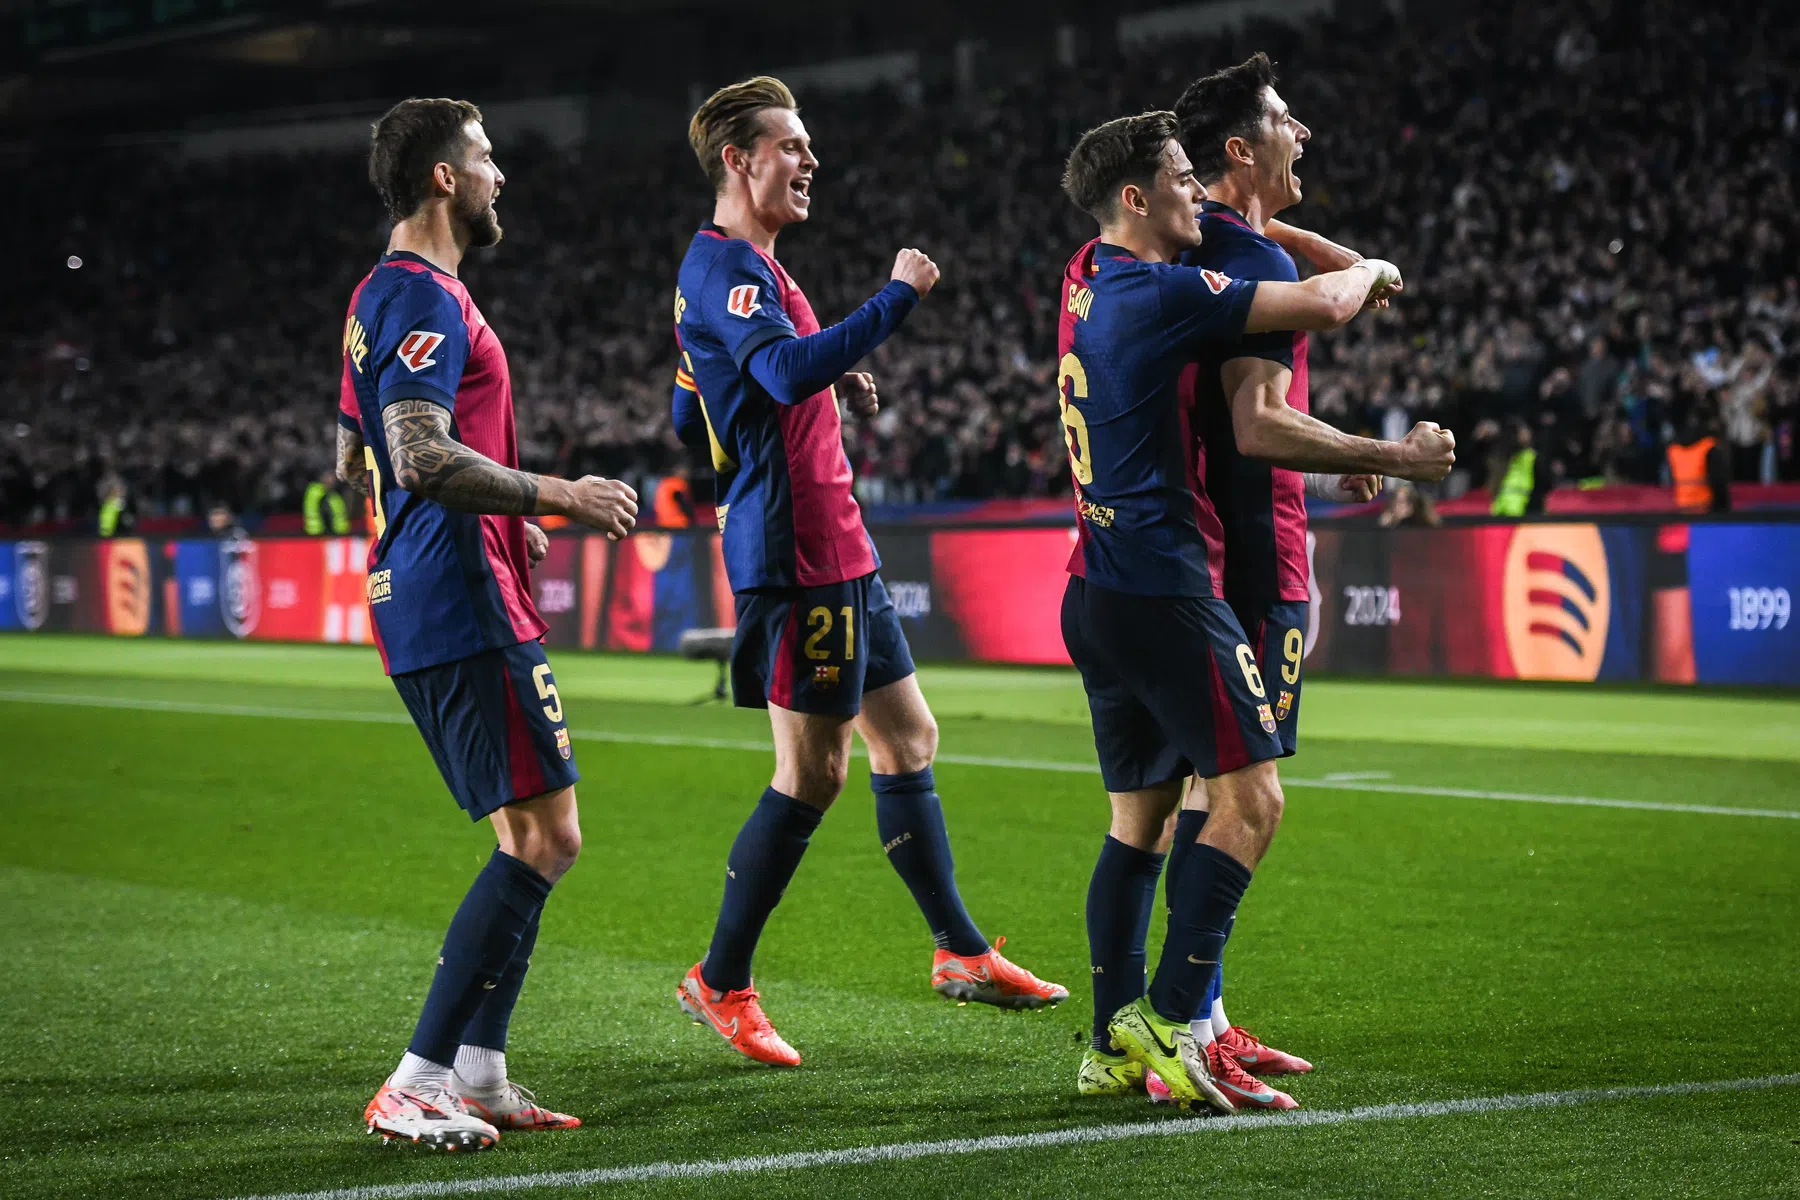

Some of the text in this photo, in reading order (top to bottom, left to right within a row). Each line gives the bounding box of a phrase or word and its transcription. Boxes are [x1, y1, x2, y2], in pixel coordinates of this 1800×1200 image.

[1067, 284, 1095, 322] GAVI
[1058, 352, 1093, 485] 6
[804, 605, 854, 660] 21
[1343, 585, 1401, 626] 2024
[1728, 586, 1791, 631] 1899
[1235, 643, 1266, 698] 6
[1281, 628, 1303, 685] 9
[532, 663, 563, 722] 5
